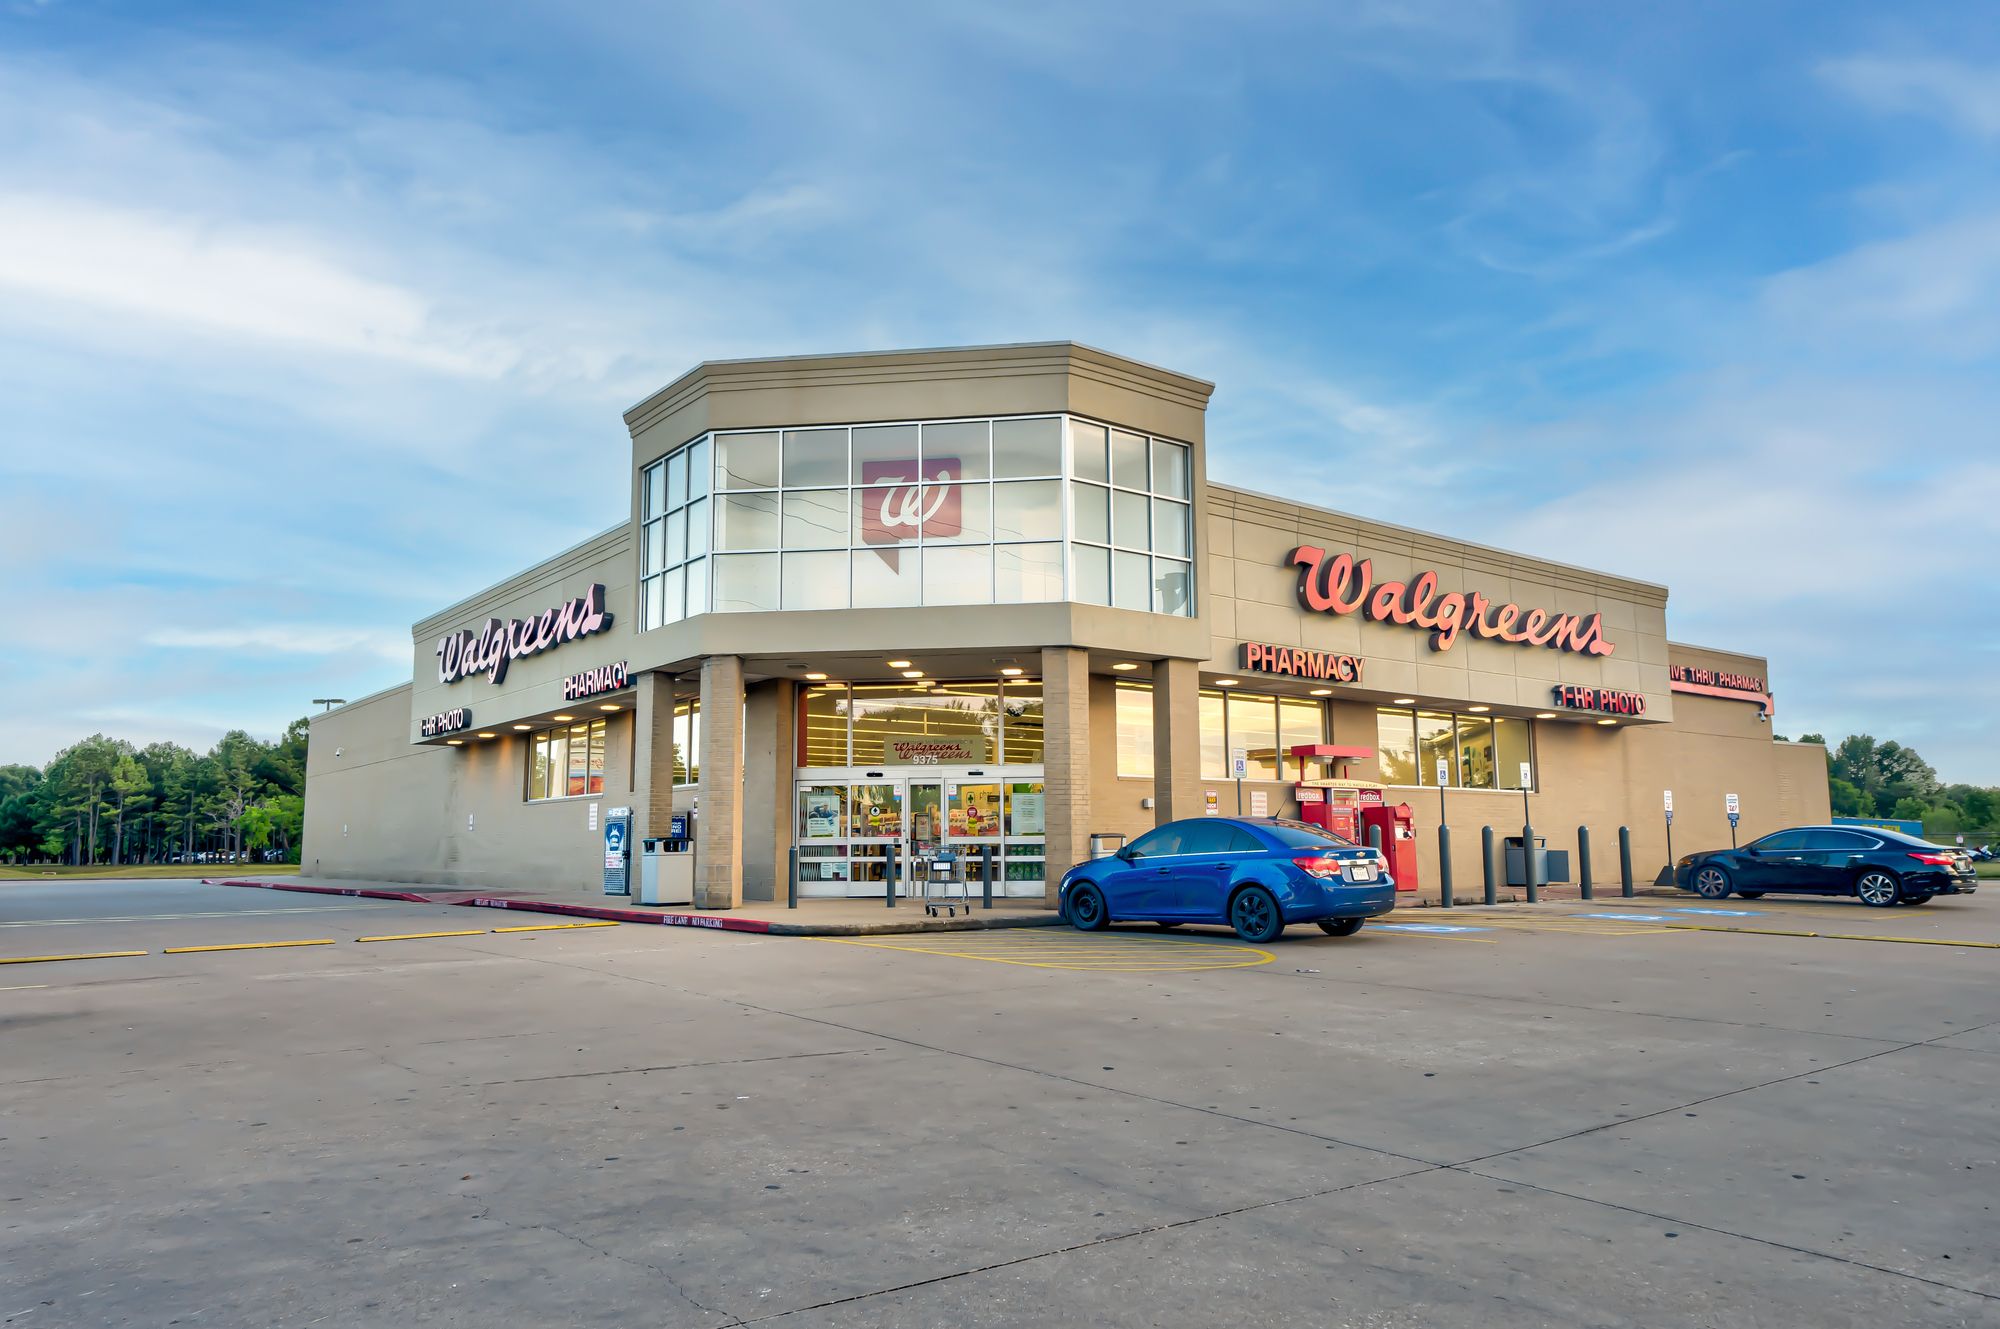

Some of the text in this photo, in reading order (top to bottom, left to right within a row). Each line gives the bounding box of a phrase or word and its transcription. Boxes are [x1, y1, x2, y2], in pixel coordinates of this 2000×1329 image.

[1294, 545, 1615, 656] Walgreens
[436, 583, 605, 685] Walgreens
[1247, 642, 1365, 682] PHARMACY
[563, 660, 629, 701] PHARMACY
[1670, 665, 1766, 692] IVE THRU PHARMACY
[1559, 684, 1647, 715] 1-HR PHOTO
[438, 707, 465, 733] PHOTO
[893, 742, 962, 756] Walgreens
[913, 755, 938, 765] 9375
[1298, 791, 1320, 799] redbox
[1360, 792, 1381, 801] redbox
[663, 915, 674, 925] FIRE
[674, 915, 689, 925] LANE
